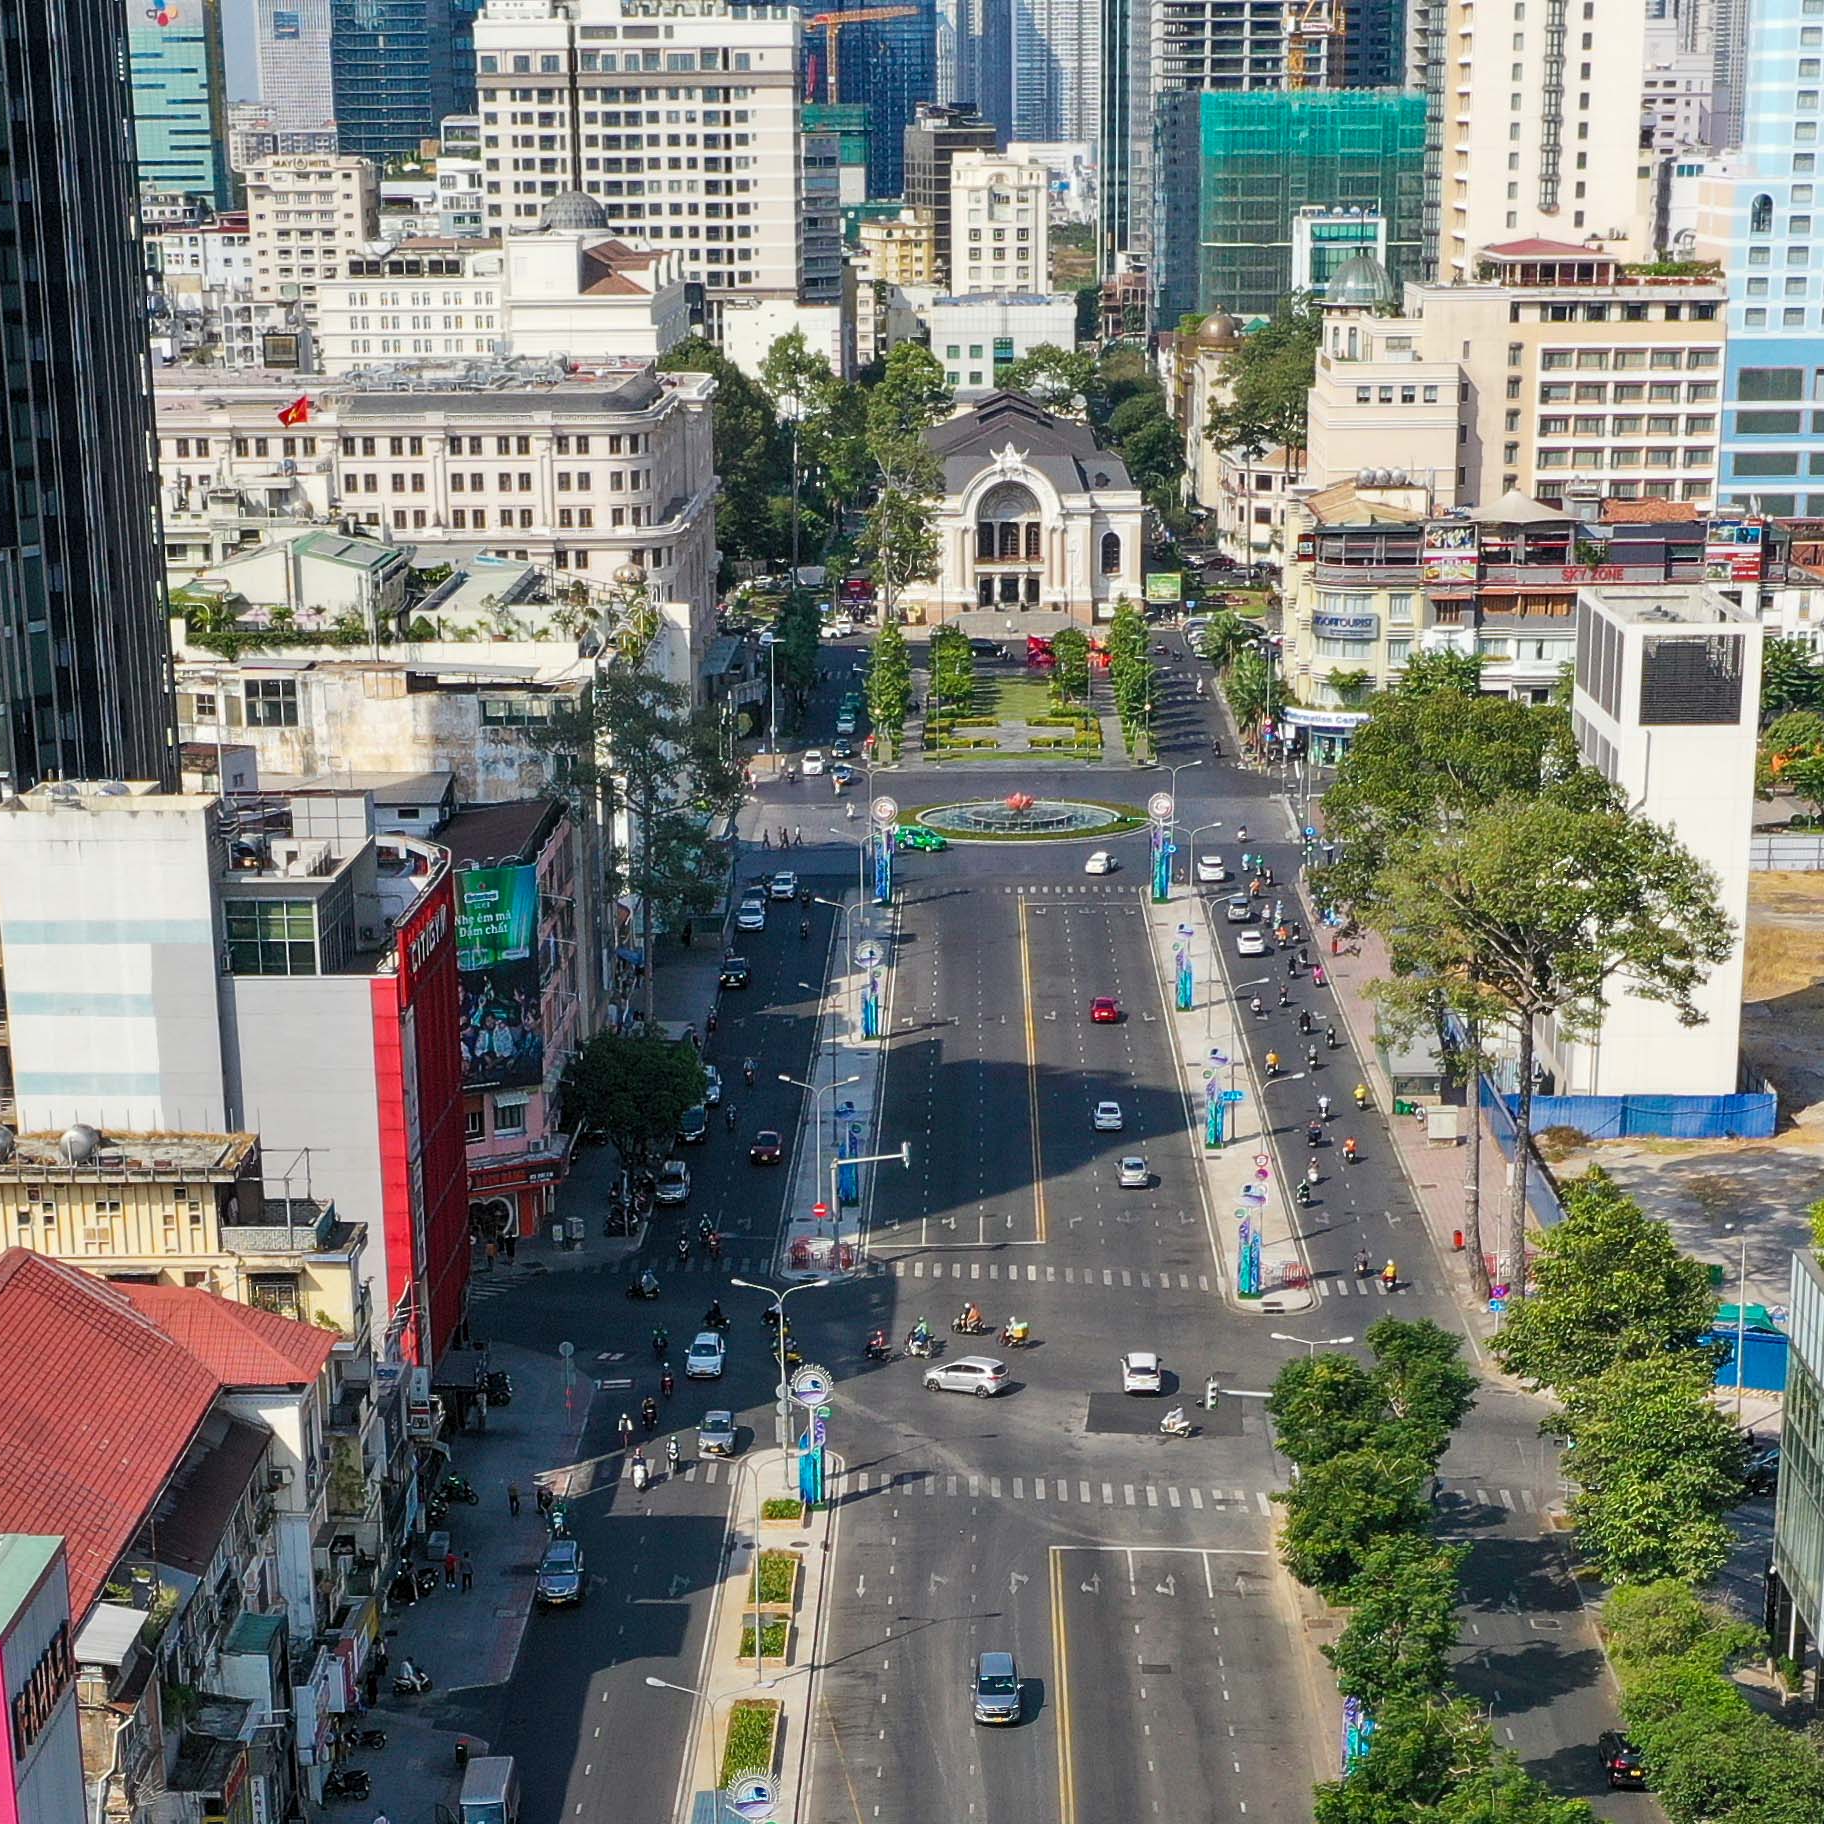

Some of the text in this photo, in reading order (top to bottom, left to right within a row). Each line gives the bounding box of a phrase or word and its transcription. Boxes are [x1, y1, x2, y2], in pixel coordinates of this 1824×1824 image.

[272, 159, 293, 168] MAY
[1561, 567, 1625, 582] SKY ZONE
